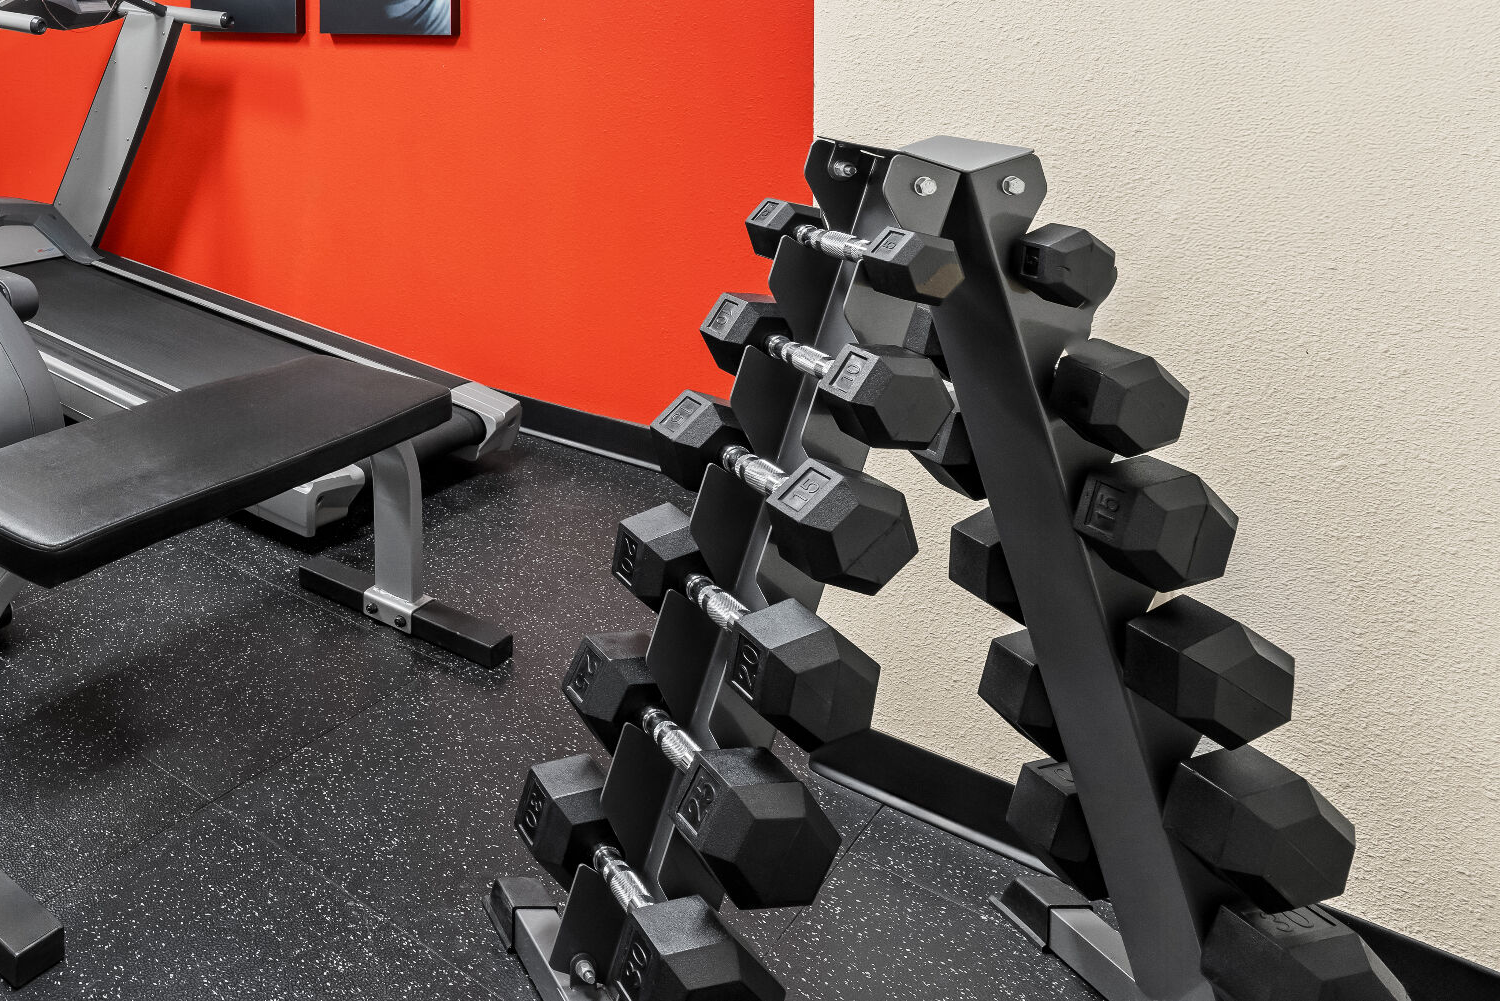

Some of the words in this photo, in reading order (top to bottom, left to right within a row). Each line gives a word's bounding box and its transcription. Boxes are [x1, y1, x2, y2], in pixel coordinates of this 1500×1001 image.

[841, 363, 861, 382] 10
[792, 478, 820, 502] 15
[1096, 493, 1120, 521] 15
[739, 644, 759, 690] 20
[688, 776, 716, 822] 25
[1260, 910, 1314, 933] 30
[625, 942, 648, 987] 30
